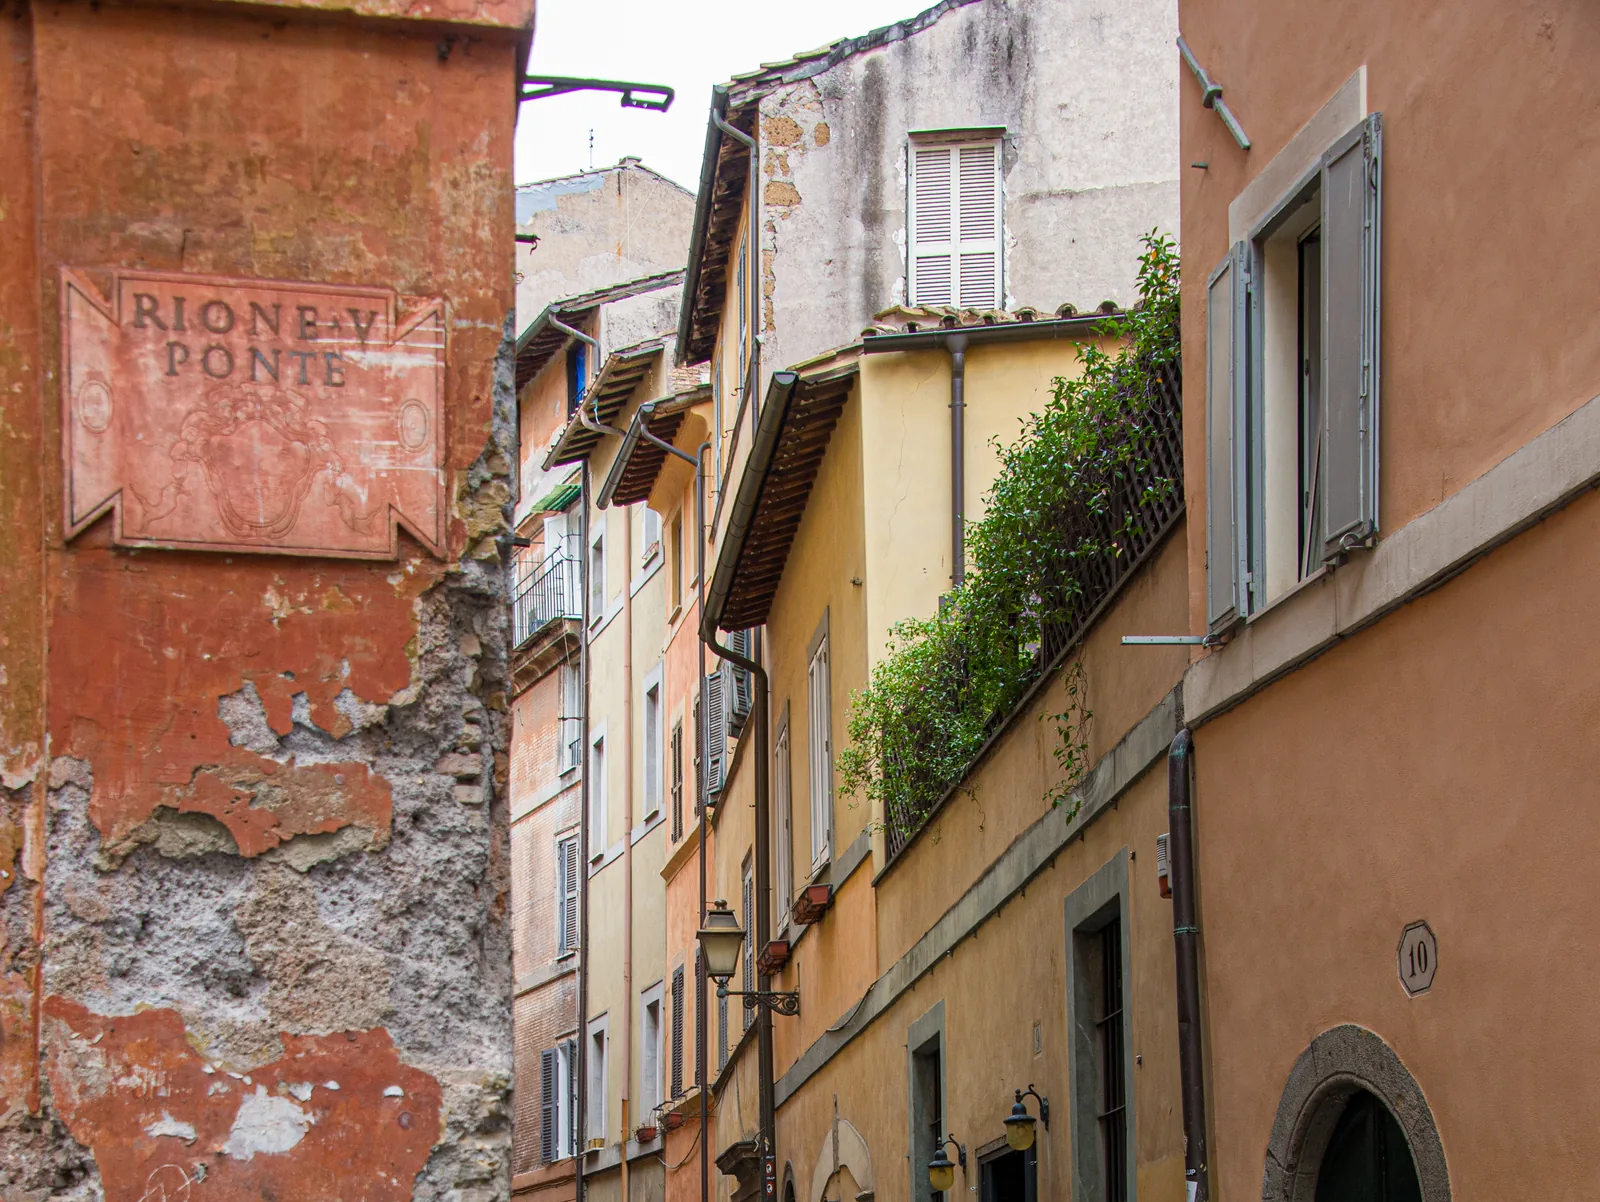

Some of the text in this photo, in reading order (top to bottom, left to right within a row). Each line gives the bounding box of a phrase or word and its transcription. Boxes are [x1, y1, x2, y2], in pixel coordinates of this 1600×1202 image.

[133, 292, 319, 341] RIONE
[165, 340, 346, 387] PONTE
[1408, 940, 1428, 978] 10
